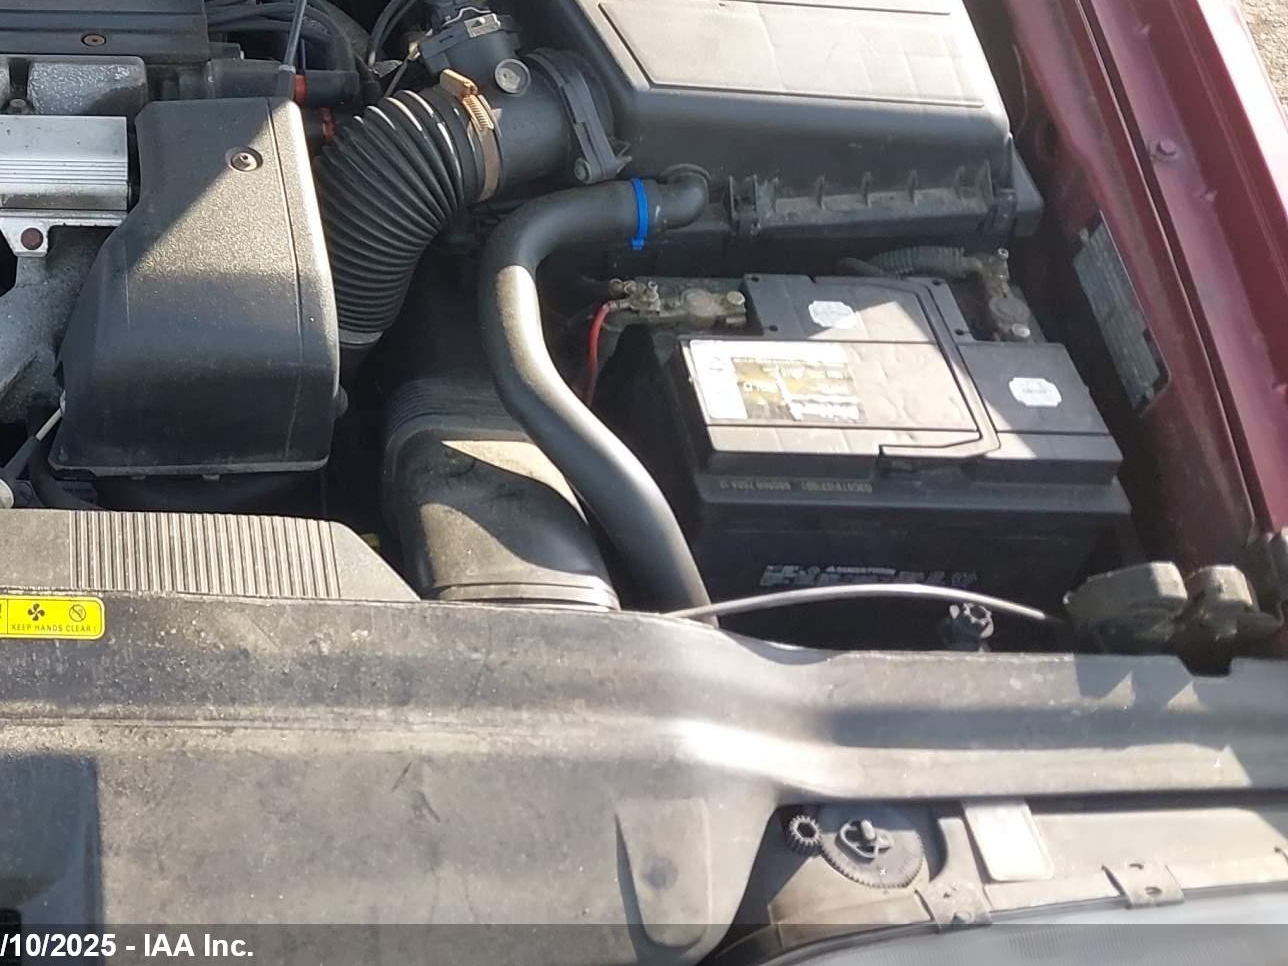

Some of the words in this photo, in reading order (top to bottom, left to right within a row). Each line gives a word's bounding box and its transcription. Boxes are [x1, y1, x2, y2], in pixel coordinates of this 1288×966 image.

[11, 624, 31, 632] KEEP
[35, 624, 63, 632] HANDS
[65, 624, 91, 632] CLEAR
